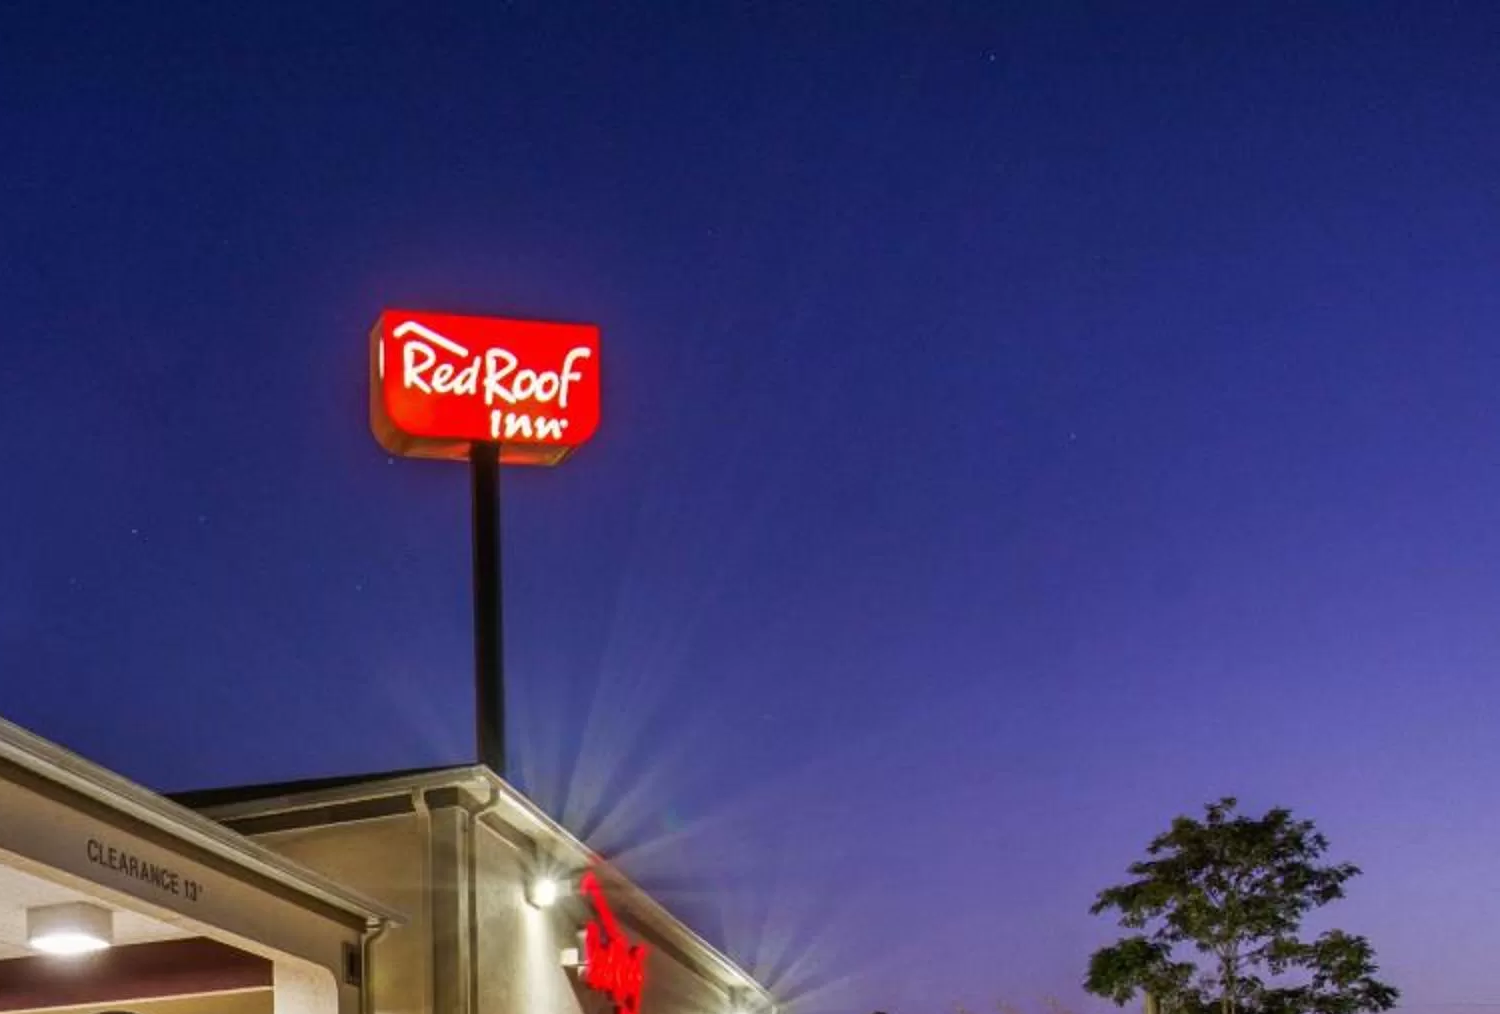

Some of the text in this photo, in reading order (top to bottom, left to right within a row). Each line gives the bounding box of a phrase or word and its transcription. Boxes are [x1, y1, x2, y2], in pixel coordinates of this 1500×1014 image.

[403, 340, 591, 408] Red Roof
[490, 409, 563, 440] Inn
[86, 838, 180, 896] CLEARANCE
